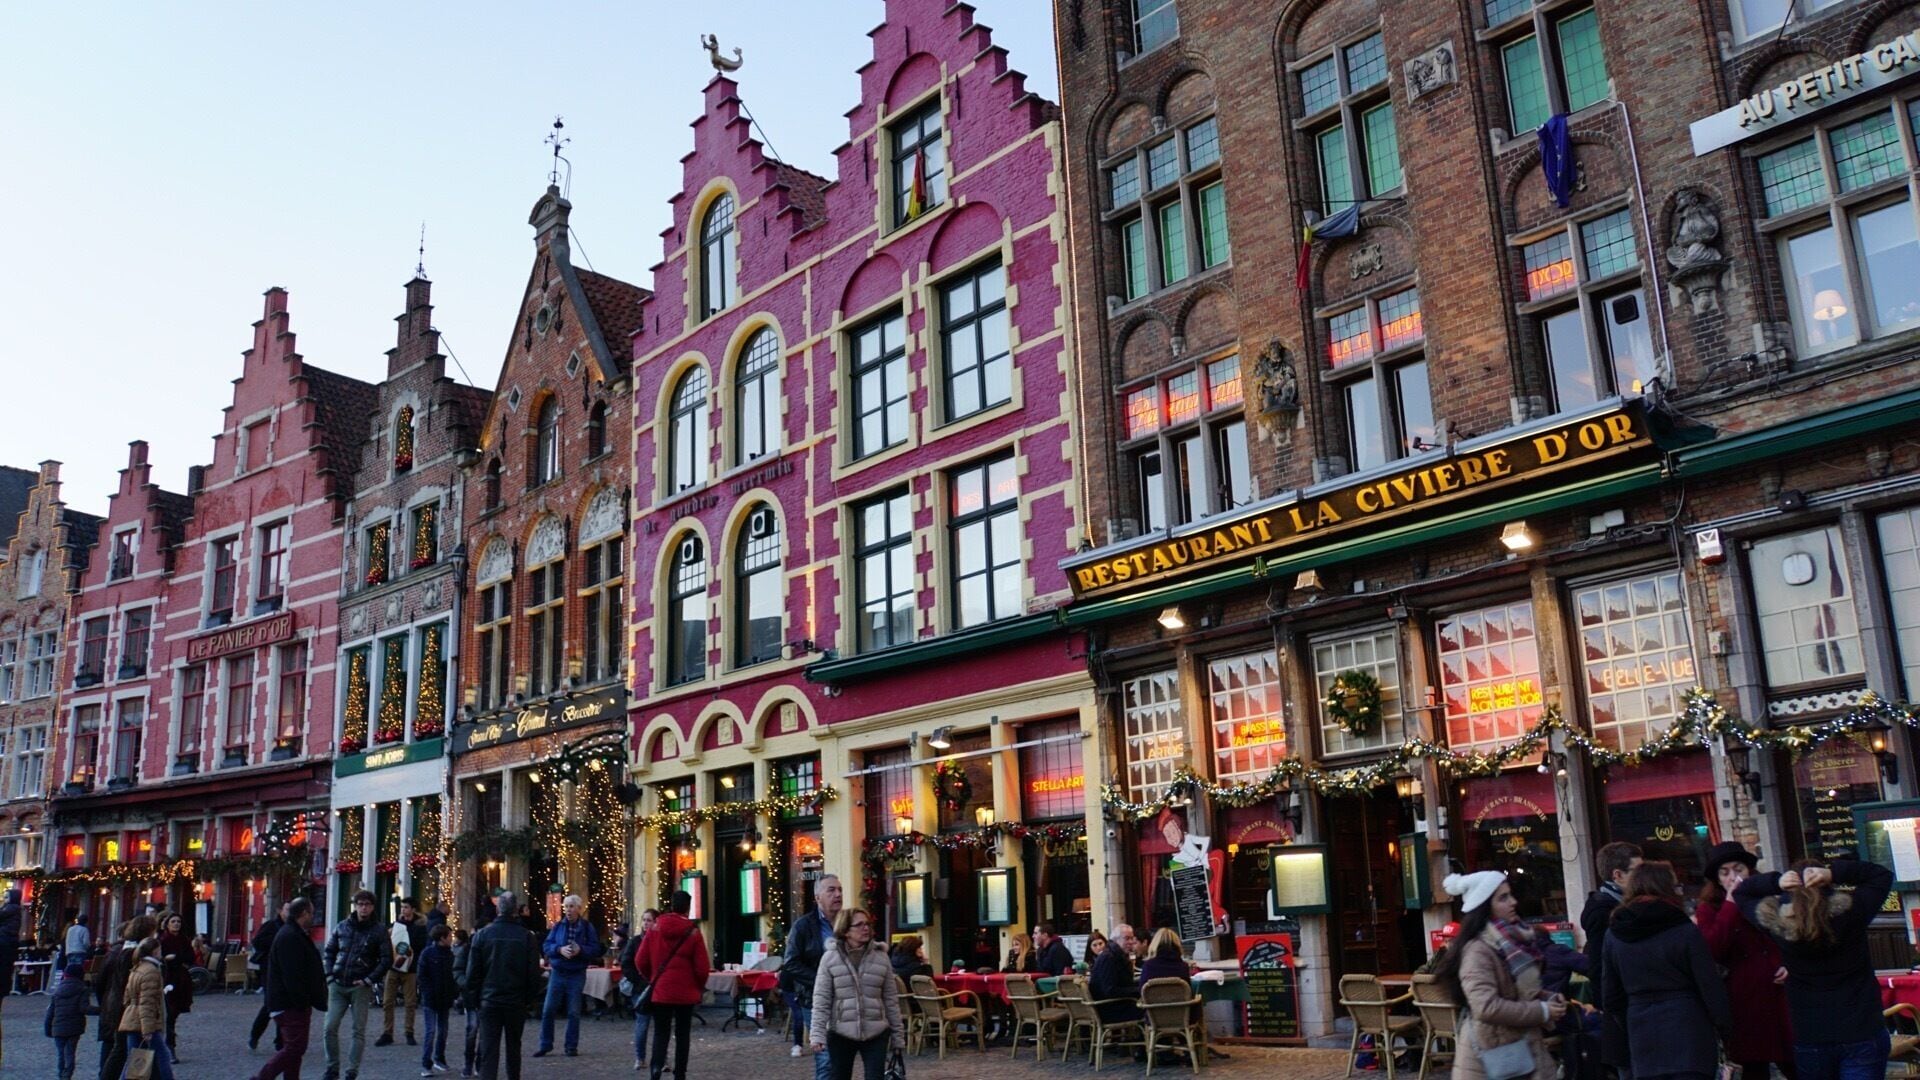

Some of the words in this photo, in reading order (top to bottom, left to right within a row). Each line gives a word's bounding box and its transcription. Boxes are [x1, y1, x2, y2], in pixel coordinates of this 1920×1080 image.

[1739, 89, 1776, 127] AU
[1779, 53, 1865, 110] PETIT
[1872, 28, 1920, 73] CA
[1076, 515, 1273, 592] RESTAURANT
[1289, 499, 1342, 533] LA
[1355, 449, 1513, 514] CIVIERE
[1533, 412, 1638, 465] D'OR
[192, 642, 207, 658] LE
[208, 625, 256, 653] PANIER
[1032, 779, 1065, 793] STELLA
[1066, 775, 1084, 789] ART
